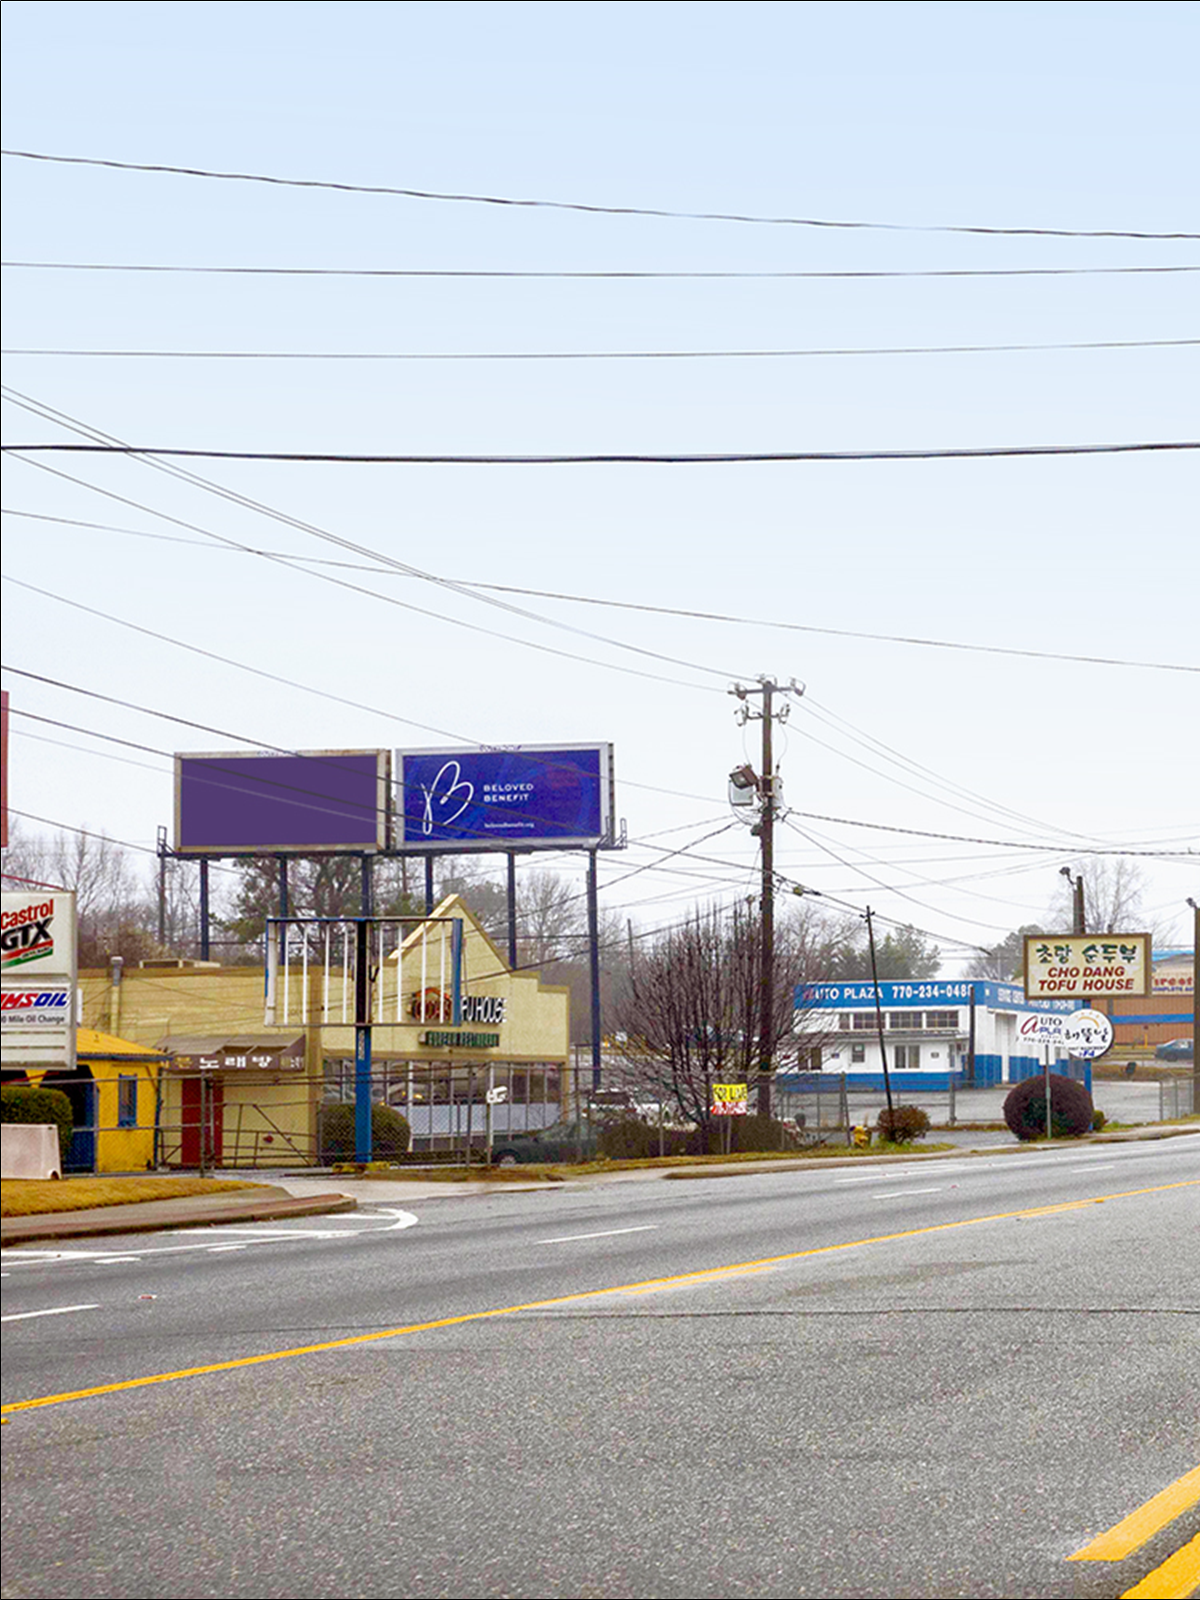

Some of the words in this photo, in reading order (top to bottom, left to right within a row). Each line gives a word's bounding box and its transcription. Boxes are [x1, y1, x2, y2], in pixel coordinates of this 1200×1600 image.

[483, 783, 534, 792] BELOVED
[483, 793, 529, 802] BENEFIT
[1, 898, 54, 930] Castrol
[1, 916, 54, 951] GTX
[1036, 943, 1072, 964] 초당
[1081, 943, 1137, 964] 순두부
[1047, 967, 1080, 978] CHO
[1082, 966, 1125, 977] DANG
[1038, 979, 1077, 991] TOFU
[1082, 978, 1135, 991] HOUSE
[843, 985, 883, 1000] PLAZA
[38, 1015, 65, 1025] Change
[1038, 1026, 1062, 1035] PLA
